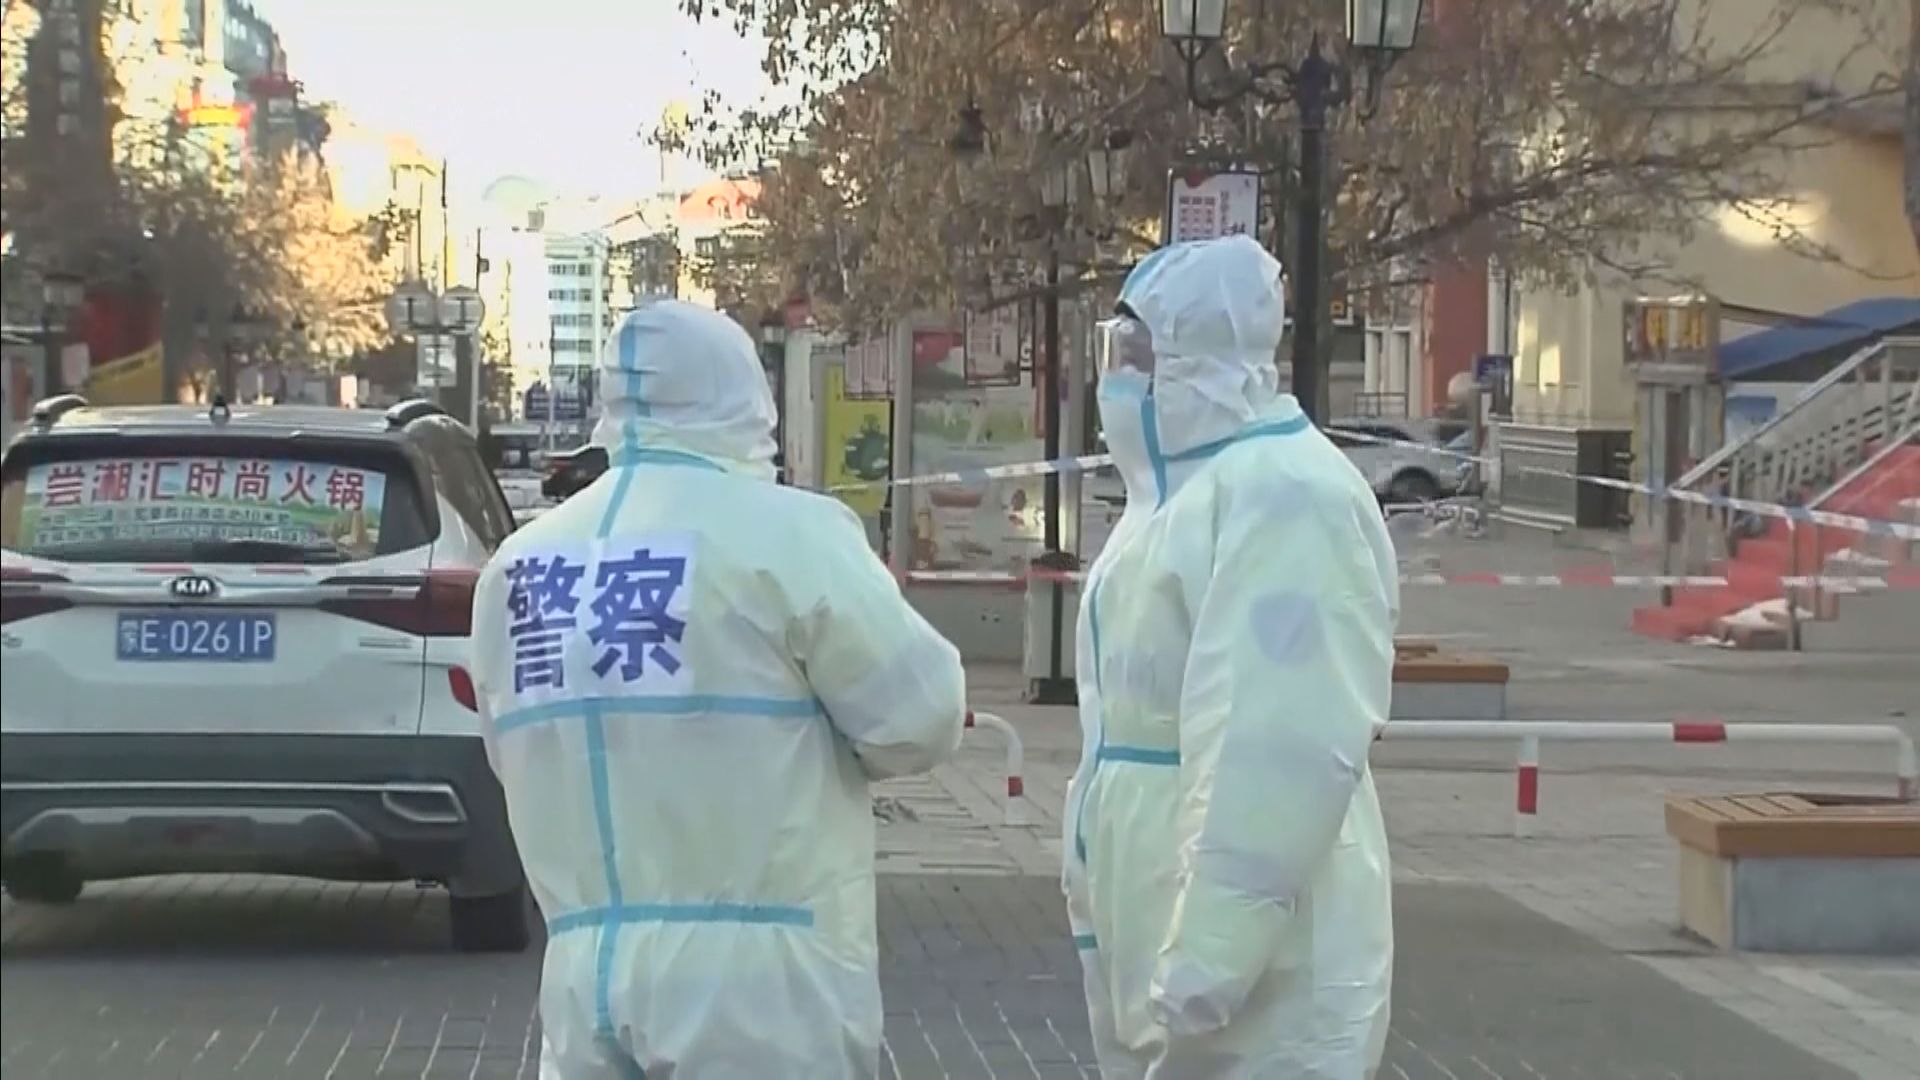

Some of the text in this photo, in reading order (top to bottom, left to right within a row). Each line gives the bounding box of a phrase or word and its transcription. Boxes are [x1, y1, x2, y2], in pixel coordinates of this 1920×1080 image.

[46, 461, 365, 512] 尝湘汇时尚火锅
[174, 578, 211, 593] KIA
[505, 549, 688, 693] 警察
